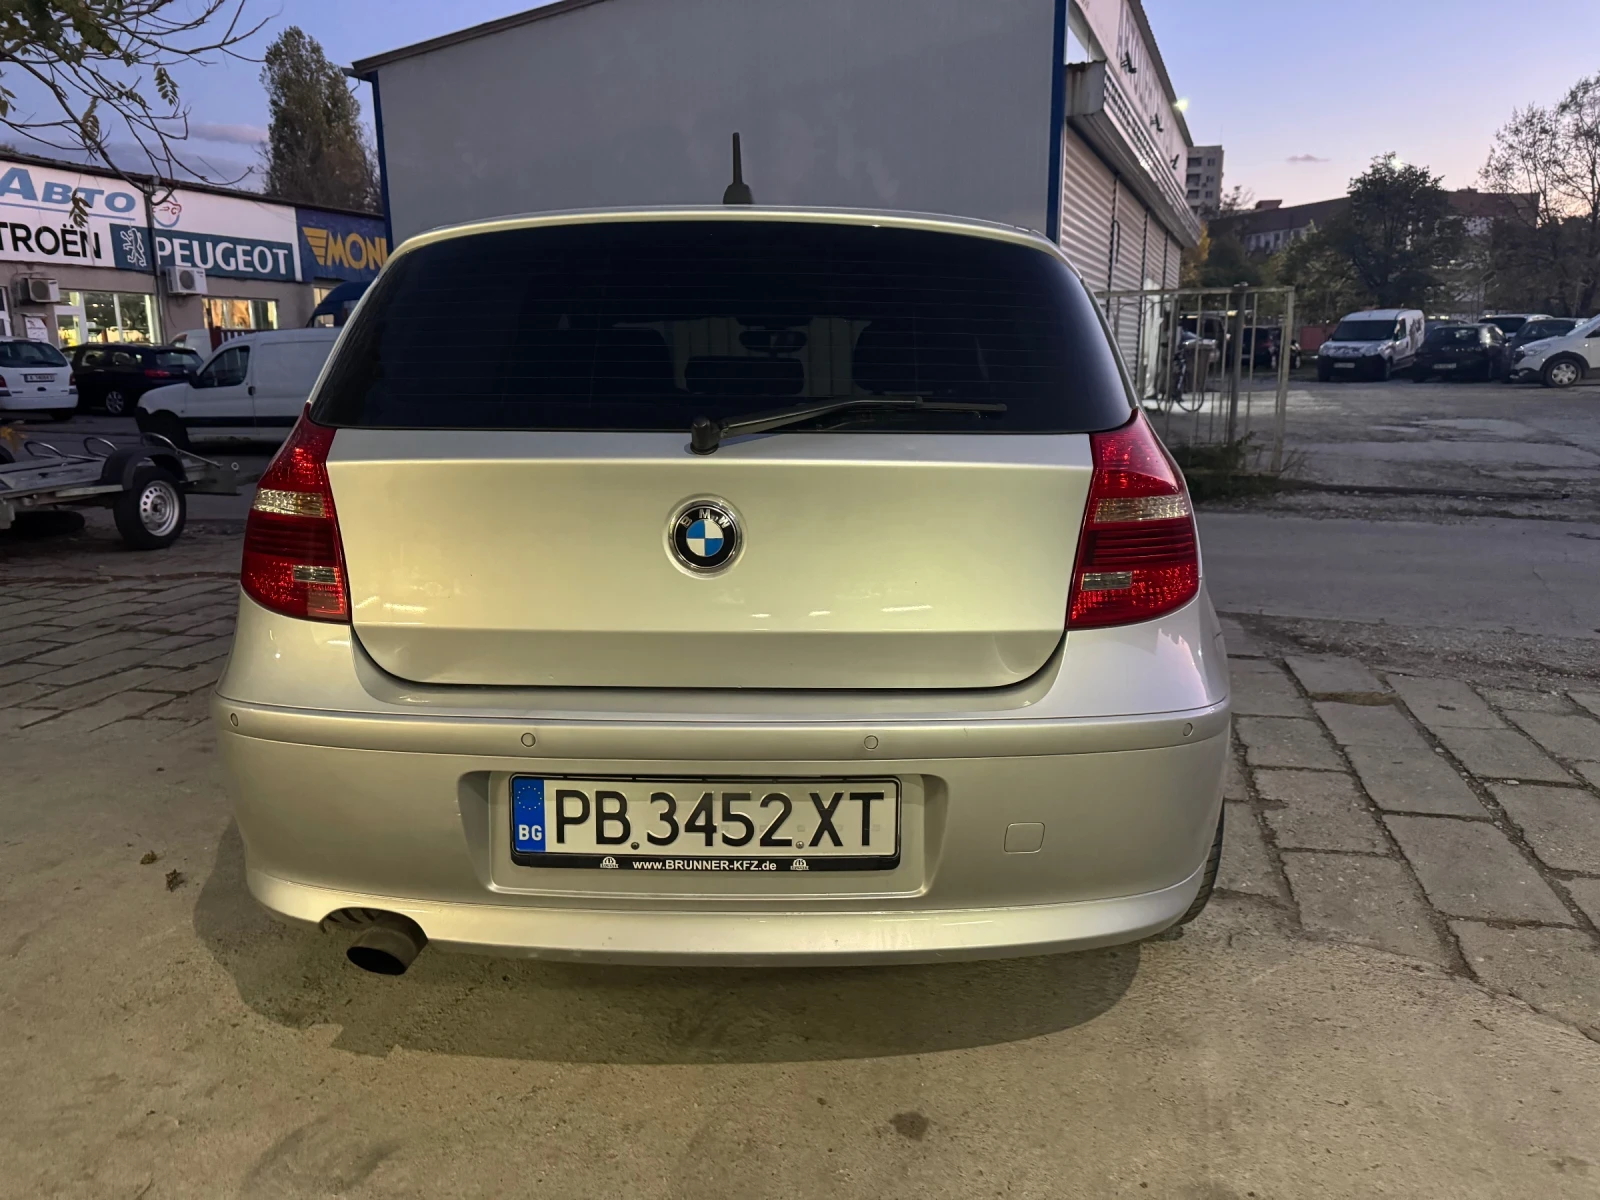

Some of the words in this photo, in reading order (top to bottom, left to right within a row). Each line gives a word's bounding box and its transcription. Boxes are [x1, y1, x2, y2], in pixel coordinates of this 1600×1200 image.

[155, 236, 289, 275] PEUGEOT
[679, 508, 731, 529] BMW
[646, 791, 793, 847] 3452
[808, 791, 885, 847] XT
[518, 824, 543, 841] BG
[632, 859, 777, 871] www.BRUNNER-KFZ.de
